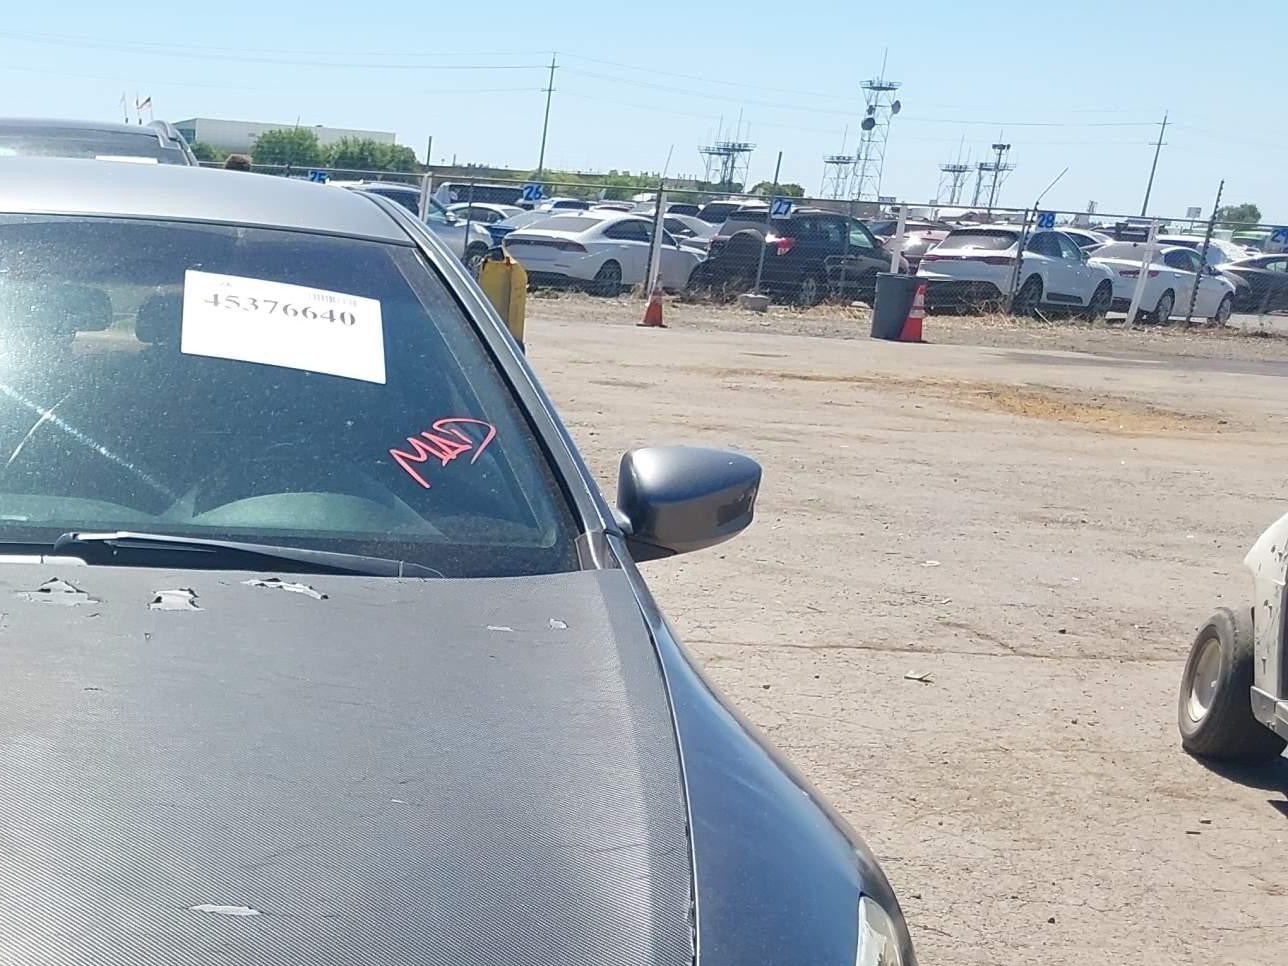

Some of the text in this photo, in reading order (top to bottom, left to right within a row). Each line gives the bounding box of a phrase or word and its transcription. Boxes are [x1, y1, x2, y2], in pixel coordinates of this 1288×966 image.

[524, 185, 543, 201] 26
[773, 199, 793, 216] 27
[1037, 213, 1056, 229] 28
[204, 292, 356, 327] 45376640
